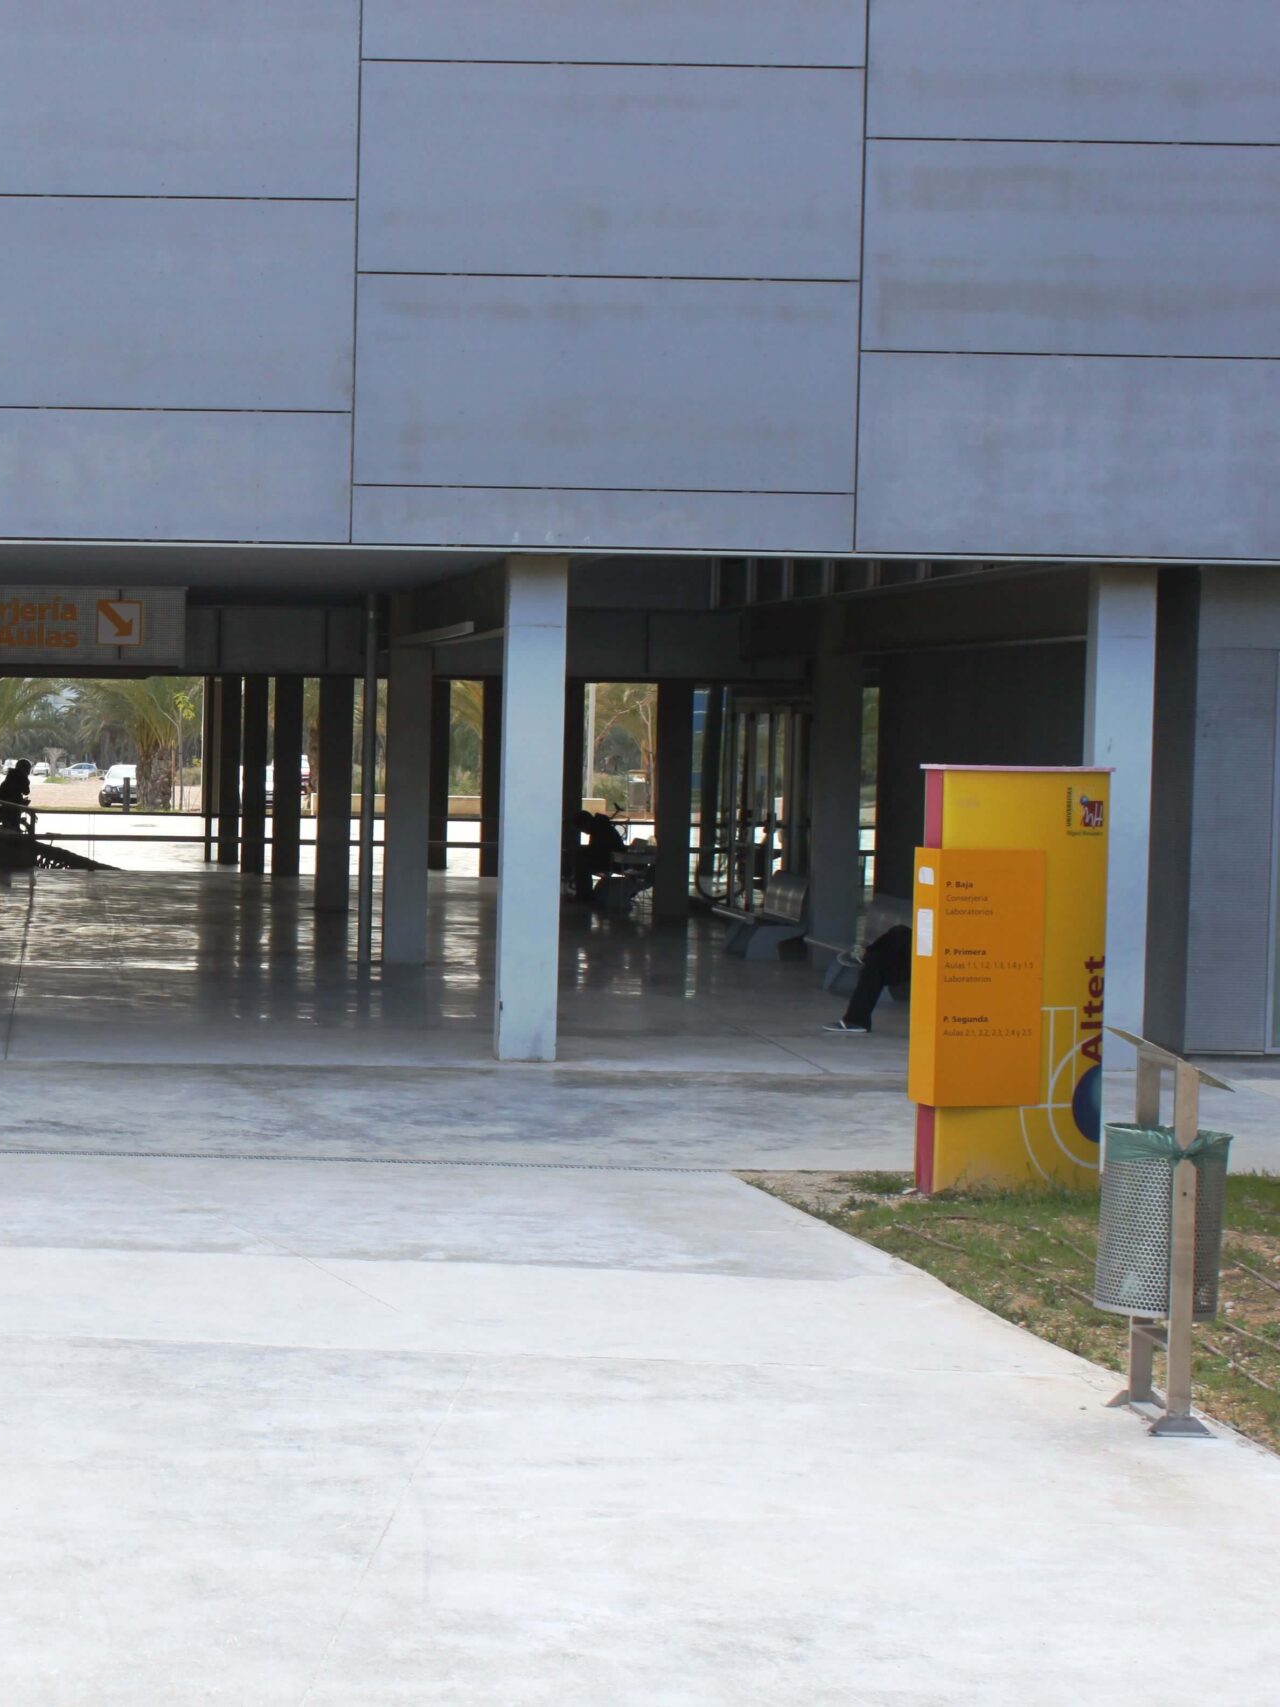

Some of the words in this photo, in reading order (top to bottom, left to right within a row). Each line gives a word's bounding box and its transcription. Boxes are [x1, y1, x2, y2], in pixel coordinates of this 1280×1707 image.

[955, 881, 974, 890] Baja
[945, 908, 994, 916] Laboratorios
[953, 948, 987, 956] Primera
[944, 961, 966, 969] Aulas
[944, 975, 992, 983] Laboratorios
[1080, 956, 1106, 1063] Altet
[951, 1015, 989, 1024] Segunda
[943, 1028, 963, 1036] Aulas
